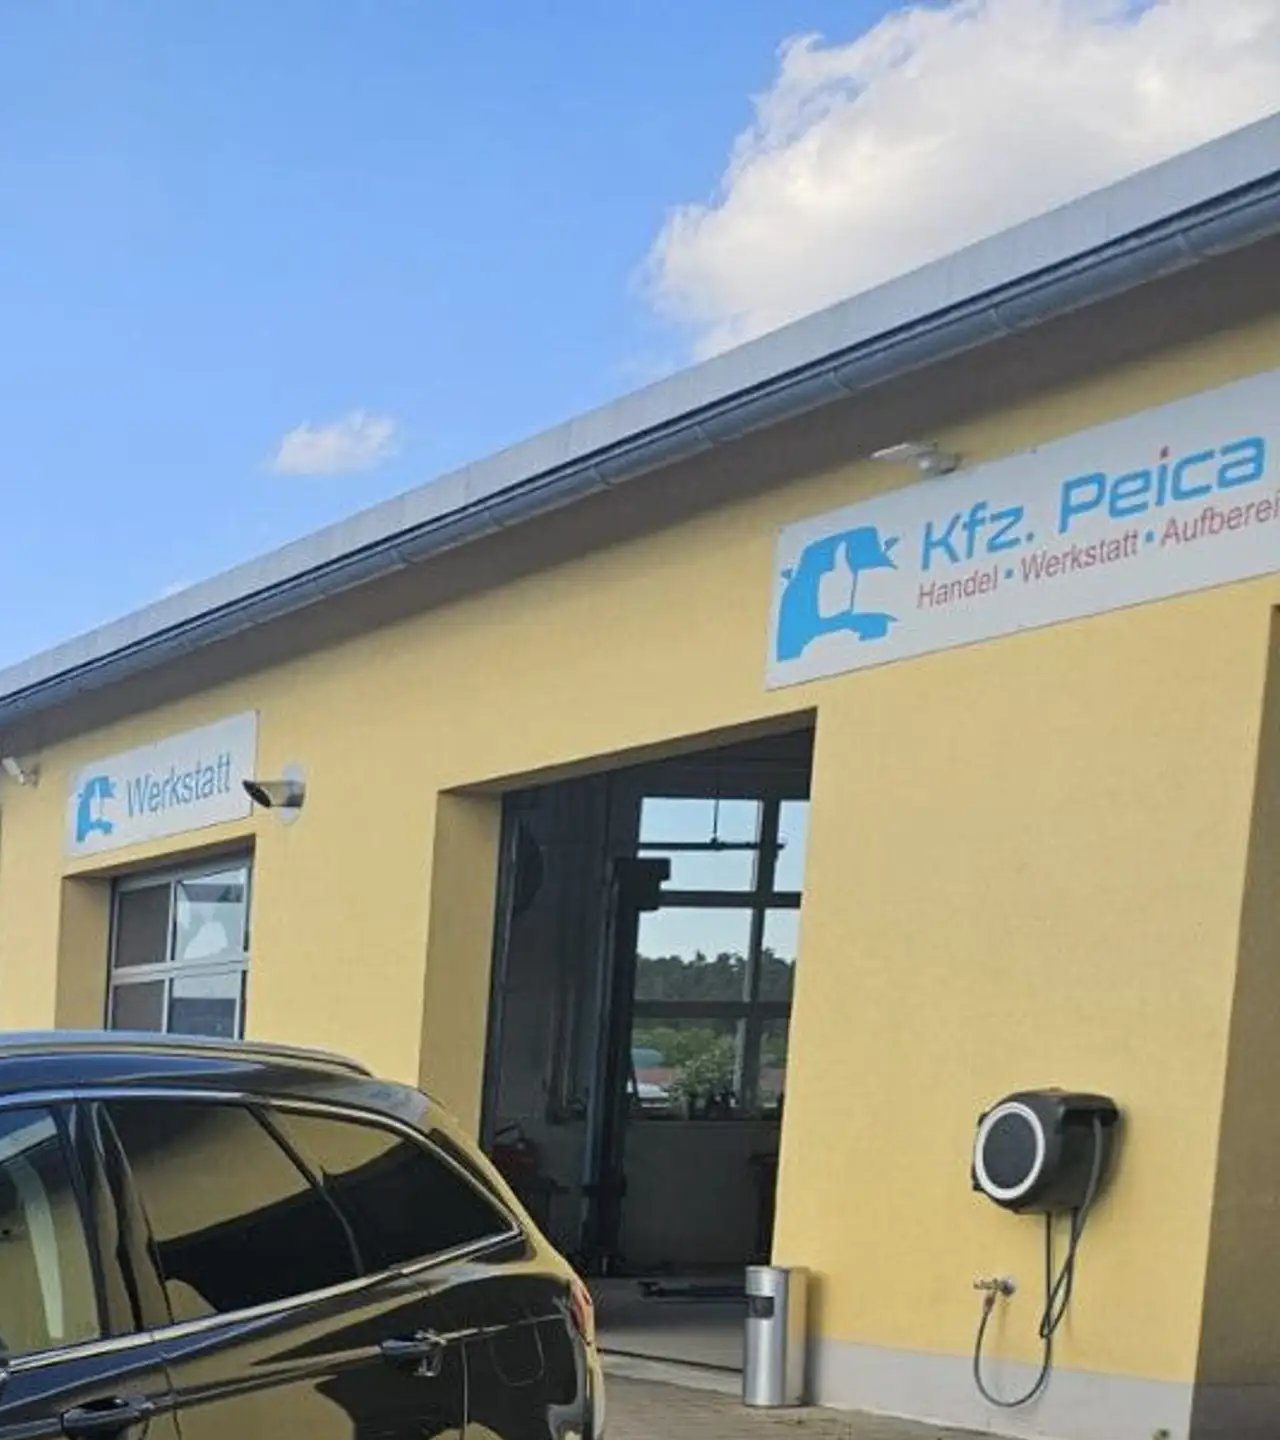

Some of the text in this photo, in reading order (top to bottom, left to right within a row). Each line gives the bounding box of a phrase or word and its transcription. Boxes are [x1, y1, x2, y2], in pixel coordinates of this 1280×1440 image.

[920, 436, 1265, 572] Kfz. Peica
[917, 565, 999, 608] Handel
[1020, 531, 1139, 583] Werkstatt
[126, 752, 232, 818] Werkstatt
